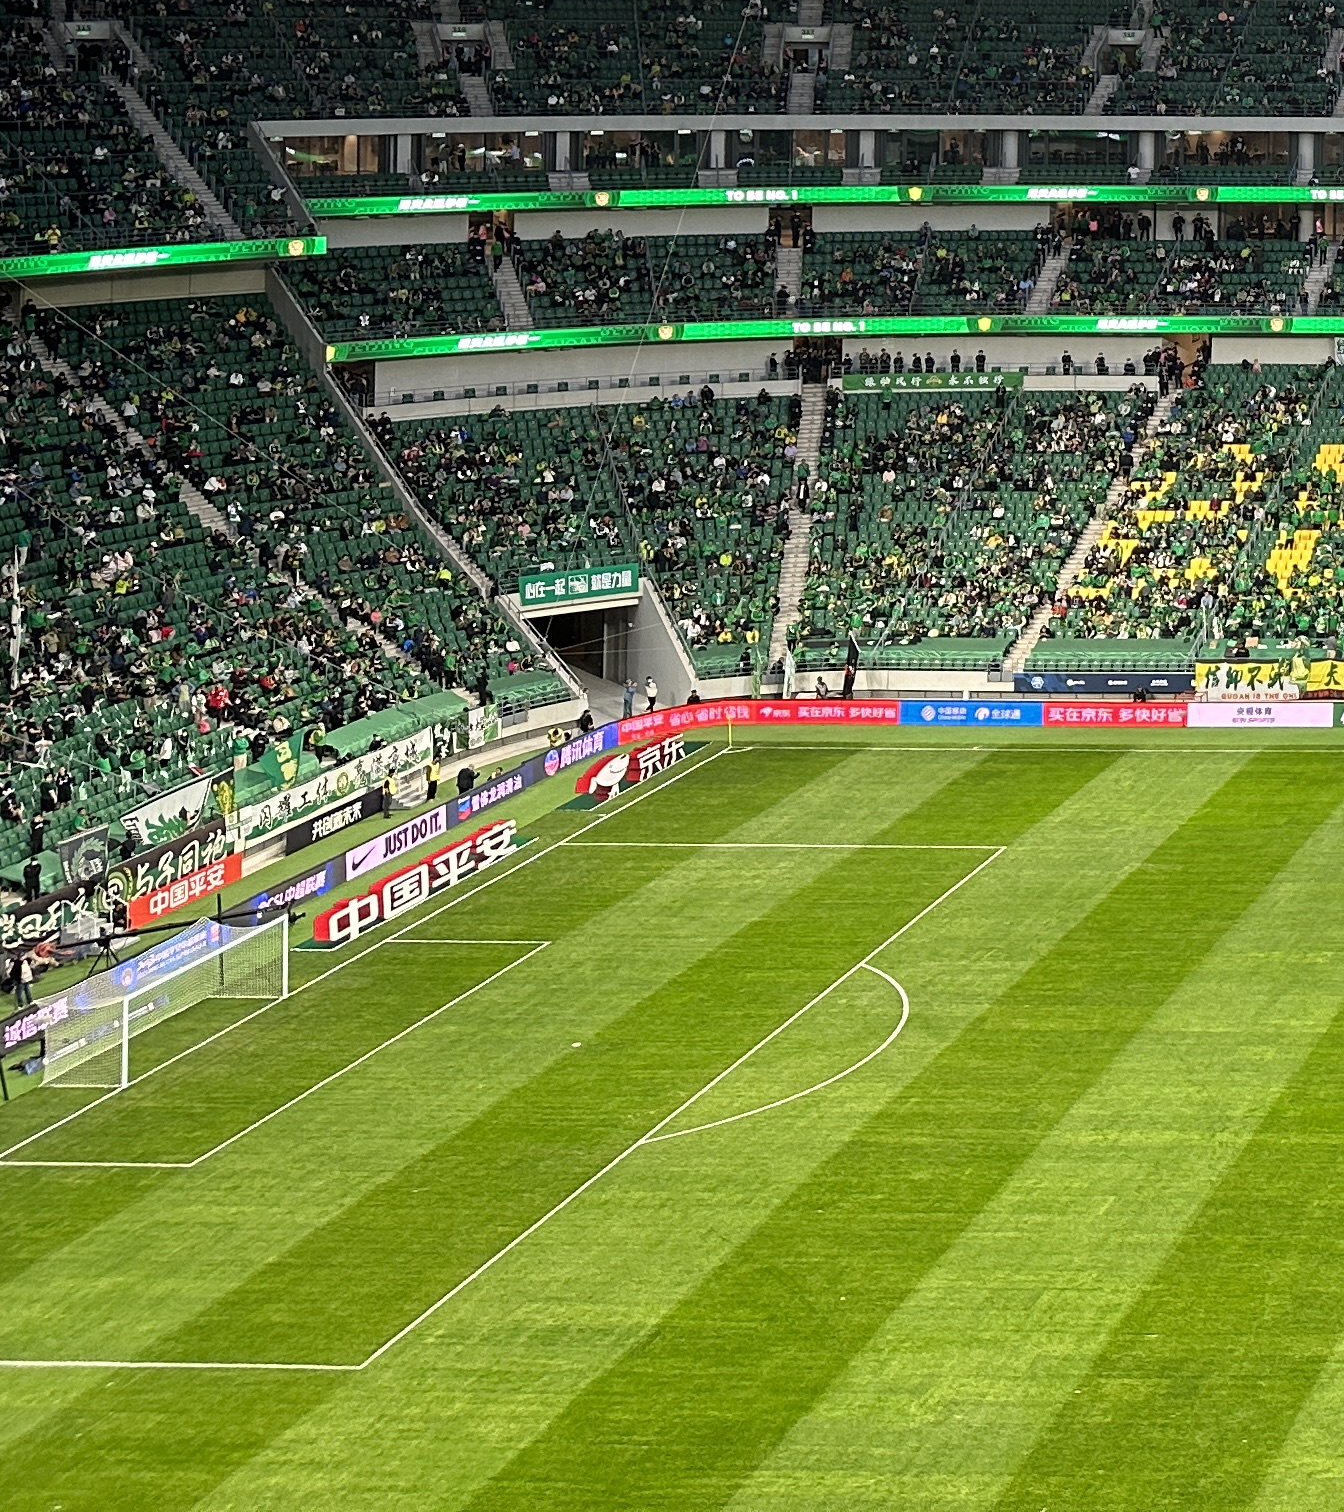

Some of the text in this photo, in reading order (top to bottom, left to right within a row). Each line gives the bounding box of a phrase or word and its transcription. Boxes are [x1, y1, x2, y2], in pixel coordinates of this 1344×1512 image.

[726, 190, 744, 201] TO
[766, 190, 789, 201] NO.
[792, 189, 798, 200] 1
[1310, 190, 1327, 200] TO
[792, 322, 810, 333] TO
[832, 321, 856, 332] NO.
[860, 321, 865, 332] 1
[797, 706, 896, 719] 买在京东 多快好省
[1048, 708, 1185, 723] 买在京东 多快好省
[560, 730, 604, 769] 腾讯体育
[637, 733, 687, 783] 京东
[383, 811, 442, 859] JUST DO IT.
[149, 864, 225, 916] 中国平安
[329, 818, 517, 942] 中国平安
